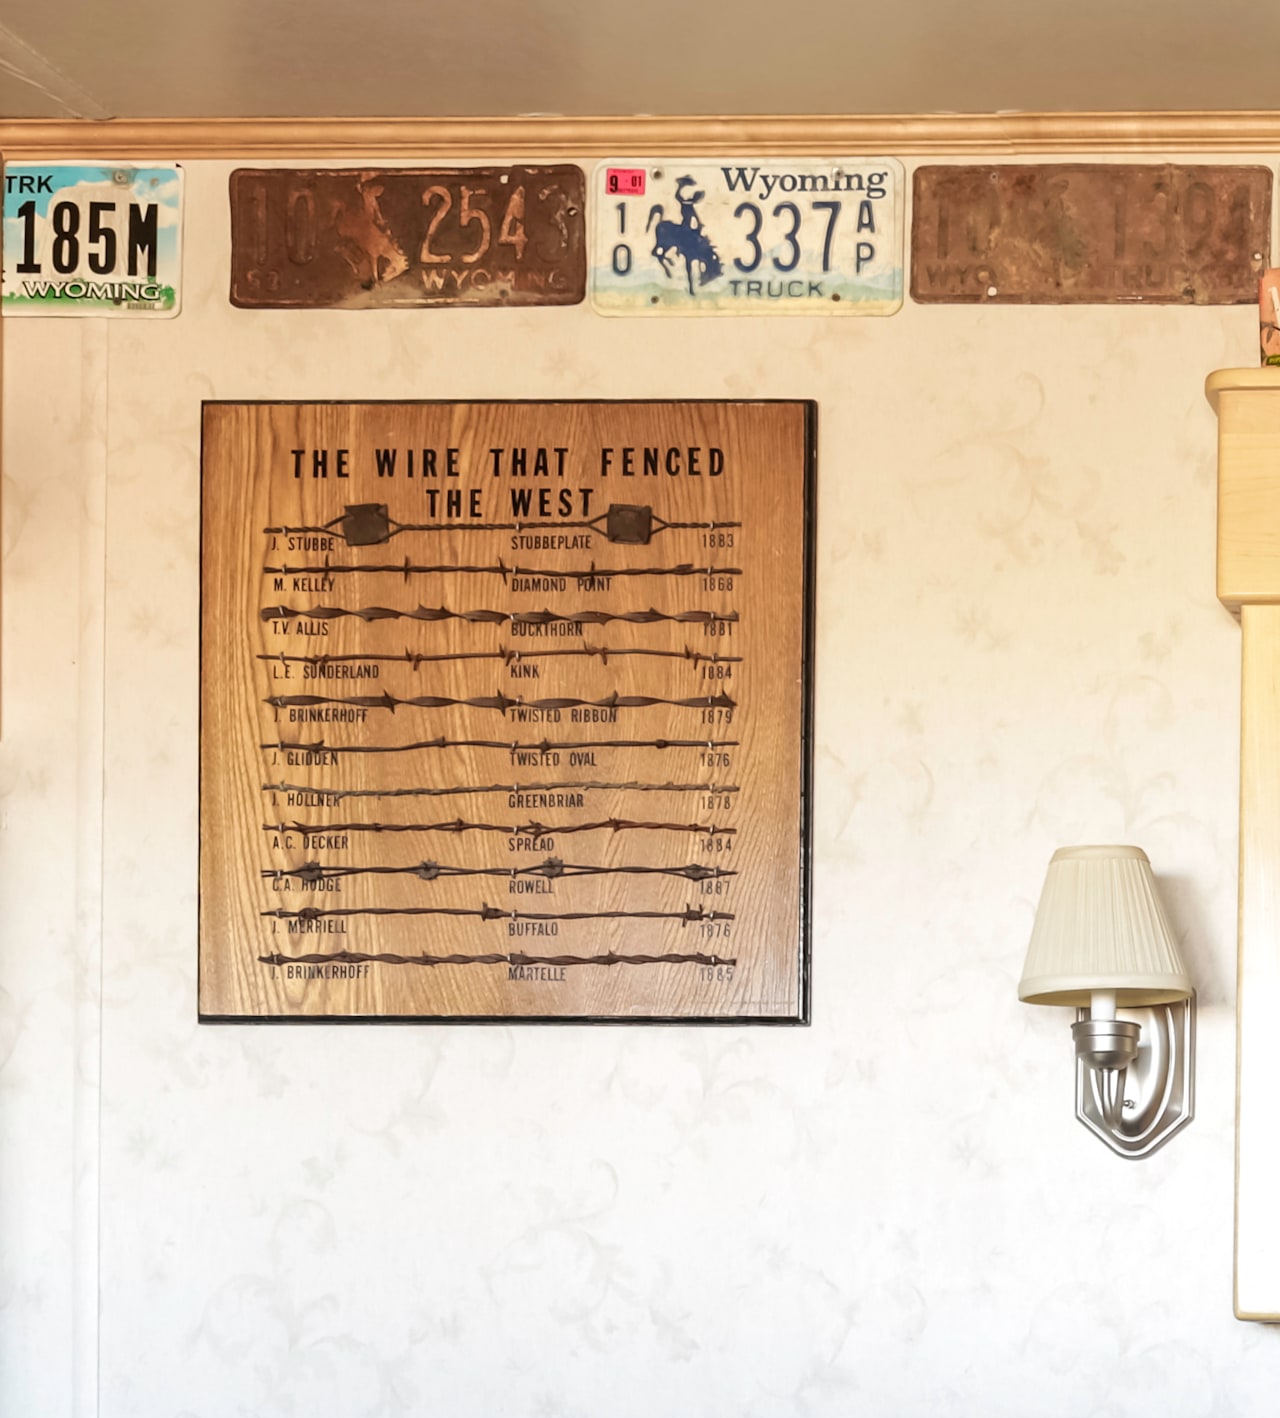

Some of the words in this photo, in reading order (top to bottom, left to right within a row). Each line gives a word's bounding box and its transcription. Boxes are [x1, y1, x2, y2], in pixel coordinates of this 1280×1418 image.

[6, 175, 54, 194] TRK
[609, 174, 619, 193] 9
[721, 167, 888, 200] Wyoming
[17, 200, 158, 277] 185M
[733, 201, 842, 273] 337
[23, 280, 162, 301] WYOMING
[729, 280, 824, 298] TRUCK
[291, 449, 349, 478] THE
[375, 448, 459, 478] WIRE
[489, 448, 568, 477] THAT
[601, 447, 724, 477] FENCED
[426, 489, 482, 518] THE
[511, 488, 594, 517] WEST
[288, 537, 334, 551] STUBBE
[511, 535, 592, 550] STUBBEPLATE
[702, 534, 734, 548] 1883
[273, 578, 287, 592] M.
[293, 577, 336, 592] KELLEY
[511, 577, 567, 593] DIAMOND
[577, 577, 612, 592] POINT
[703, 577, 734, 592] 1868
[296, 621, 329, 636] ALLIS
[511, 621, 583, 637] BUCKTHORN
[702, 622, 733, 637] 1881
[273, 664, 295, 679] L.E.
[303, 664, 379, 679] SUNDERLAND
[510, 664, 540, 679] KINK
[701, 664, 732, 680] 1884
[289, 708, 368, 723] BRINKERHOFF
[510, 708, 561, 723] TWISTED
[571, 708, 618, 723] RIBBON
[701, 709, 732, 725] 1879
[287, 751, 339, 766] GLIDDEN
[509, 751, 560, 767] TWISTED
[569, 751, 598, 767] OVAL
[701, 752, 730, 767] 1876
[508, 793, 584, 808] GREENBRIAR
[701, 795, 731, 810] 1878
[303, 835, 348, 850] DECKER
[508, 837, 554, 852] SPREAD
[700, 837, 732, 852] 1884
[509, 879, 554, 895] ROWELL
[700, 880, 731, 895] 1887
[288, 919, 347, 934] MERRIELL
[508, 922, 558, 937] BUFFALO
[700, 923, 731, 939] 1876
[508, 966, 566, 982] MARTELLE
